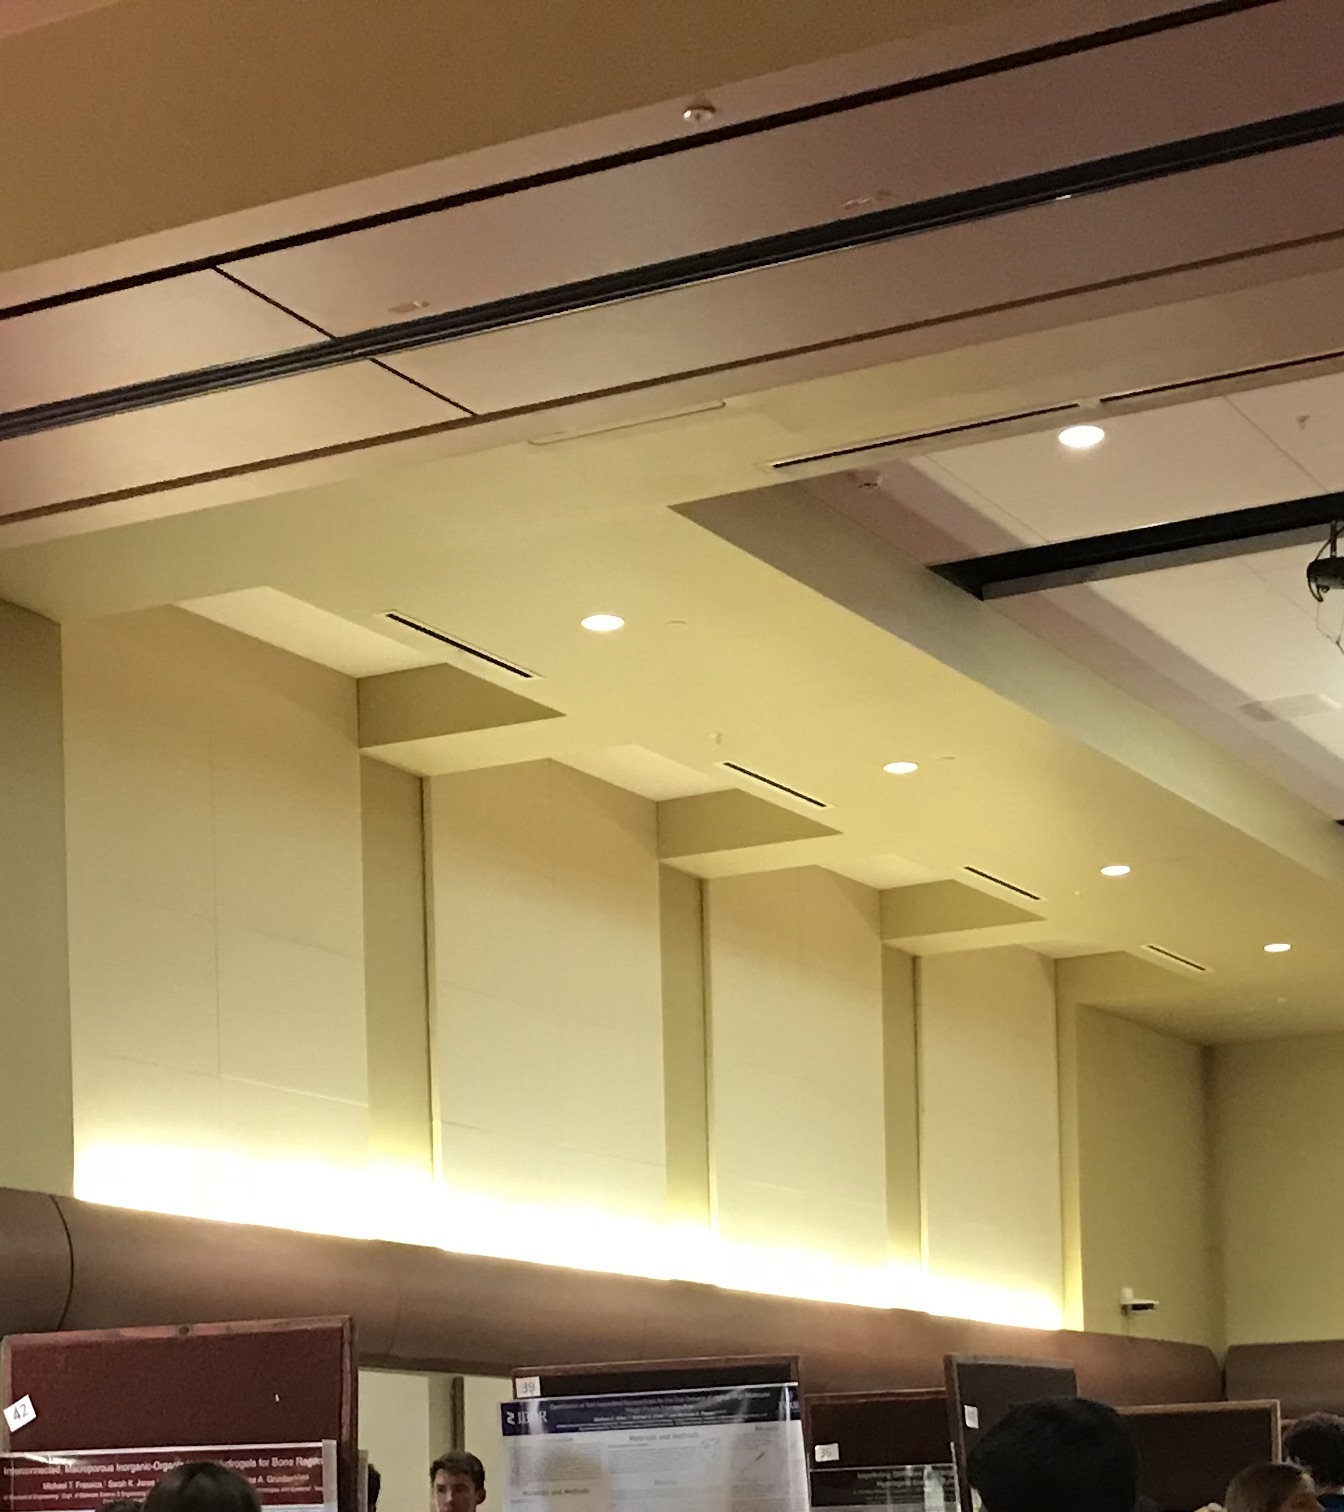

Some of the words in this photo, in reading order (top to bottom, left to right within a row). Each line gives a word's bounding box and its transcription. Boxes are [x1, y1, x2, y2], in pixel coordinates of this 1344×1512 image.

[521, 1381, 536, 1394] 39
[13, 1403, 29, 1420] 42
[258, 1457, 270, 1467] for
[271, 1457, 294, 1467] Bone
